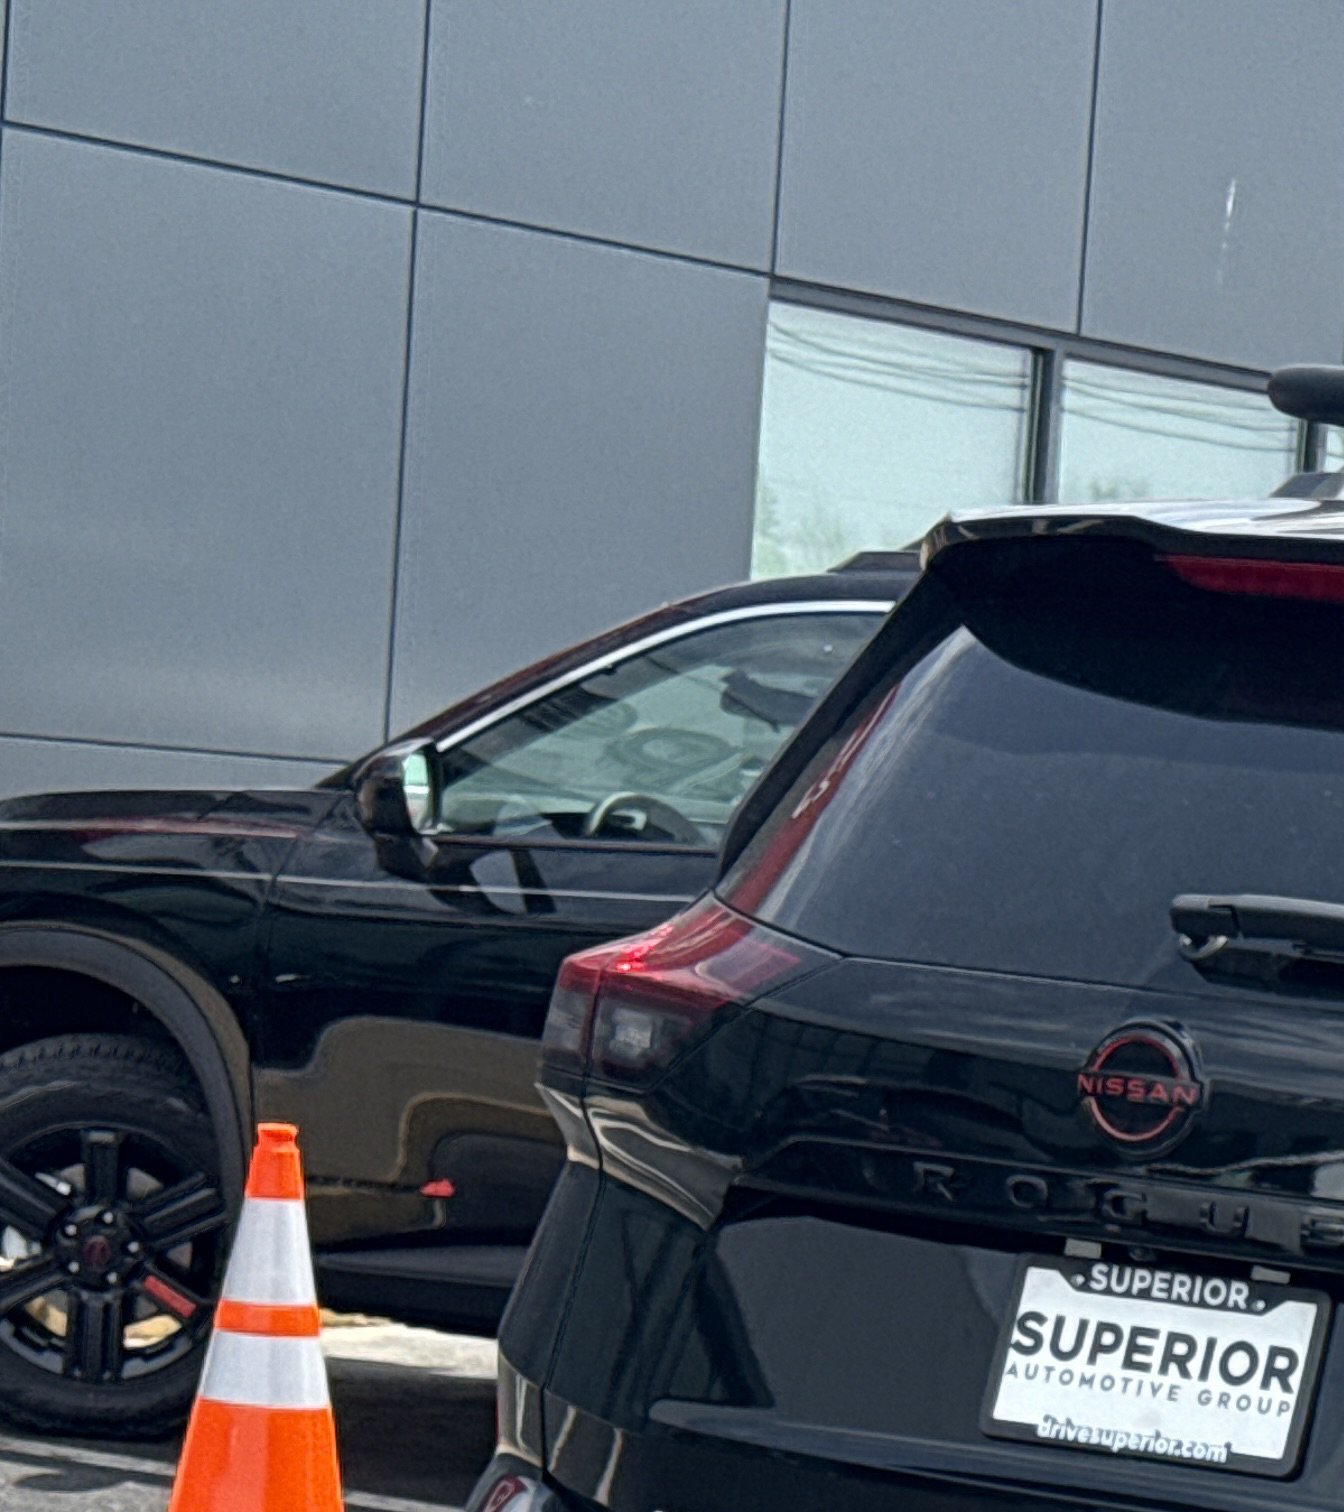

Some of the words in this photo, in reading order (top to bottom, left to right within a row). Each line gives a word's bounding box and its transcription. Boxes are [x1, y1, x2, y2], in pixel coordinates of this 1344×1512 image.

[1077, 1072, 1199, 1106] NISSAN
[1089, 1263, 1250, 1310] SUPERIOR
[1010, 1311, 1300, 1395] SUPERIOR
[1005, 1362, 1183, 1402] AUTOMOTIVE
[1197, 1388, 1292, 1417] GROUP
